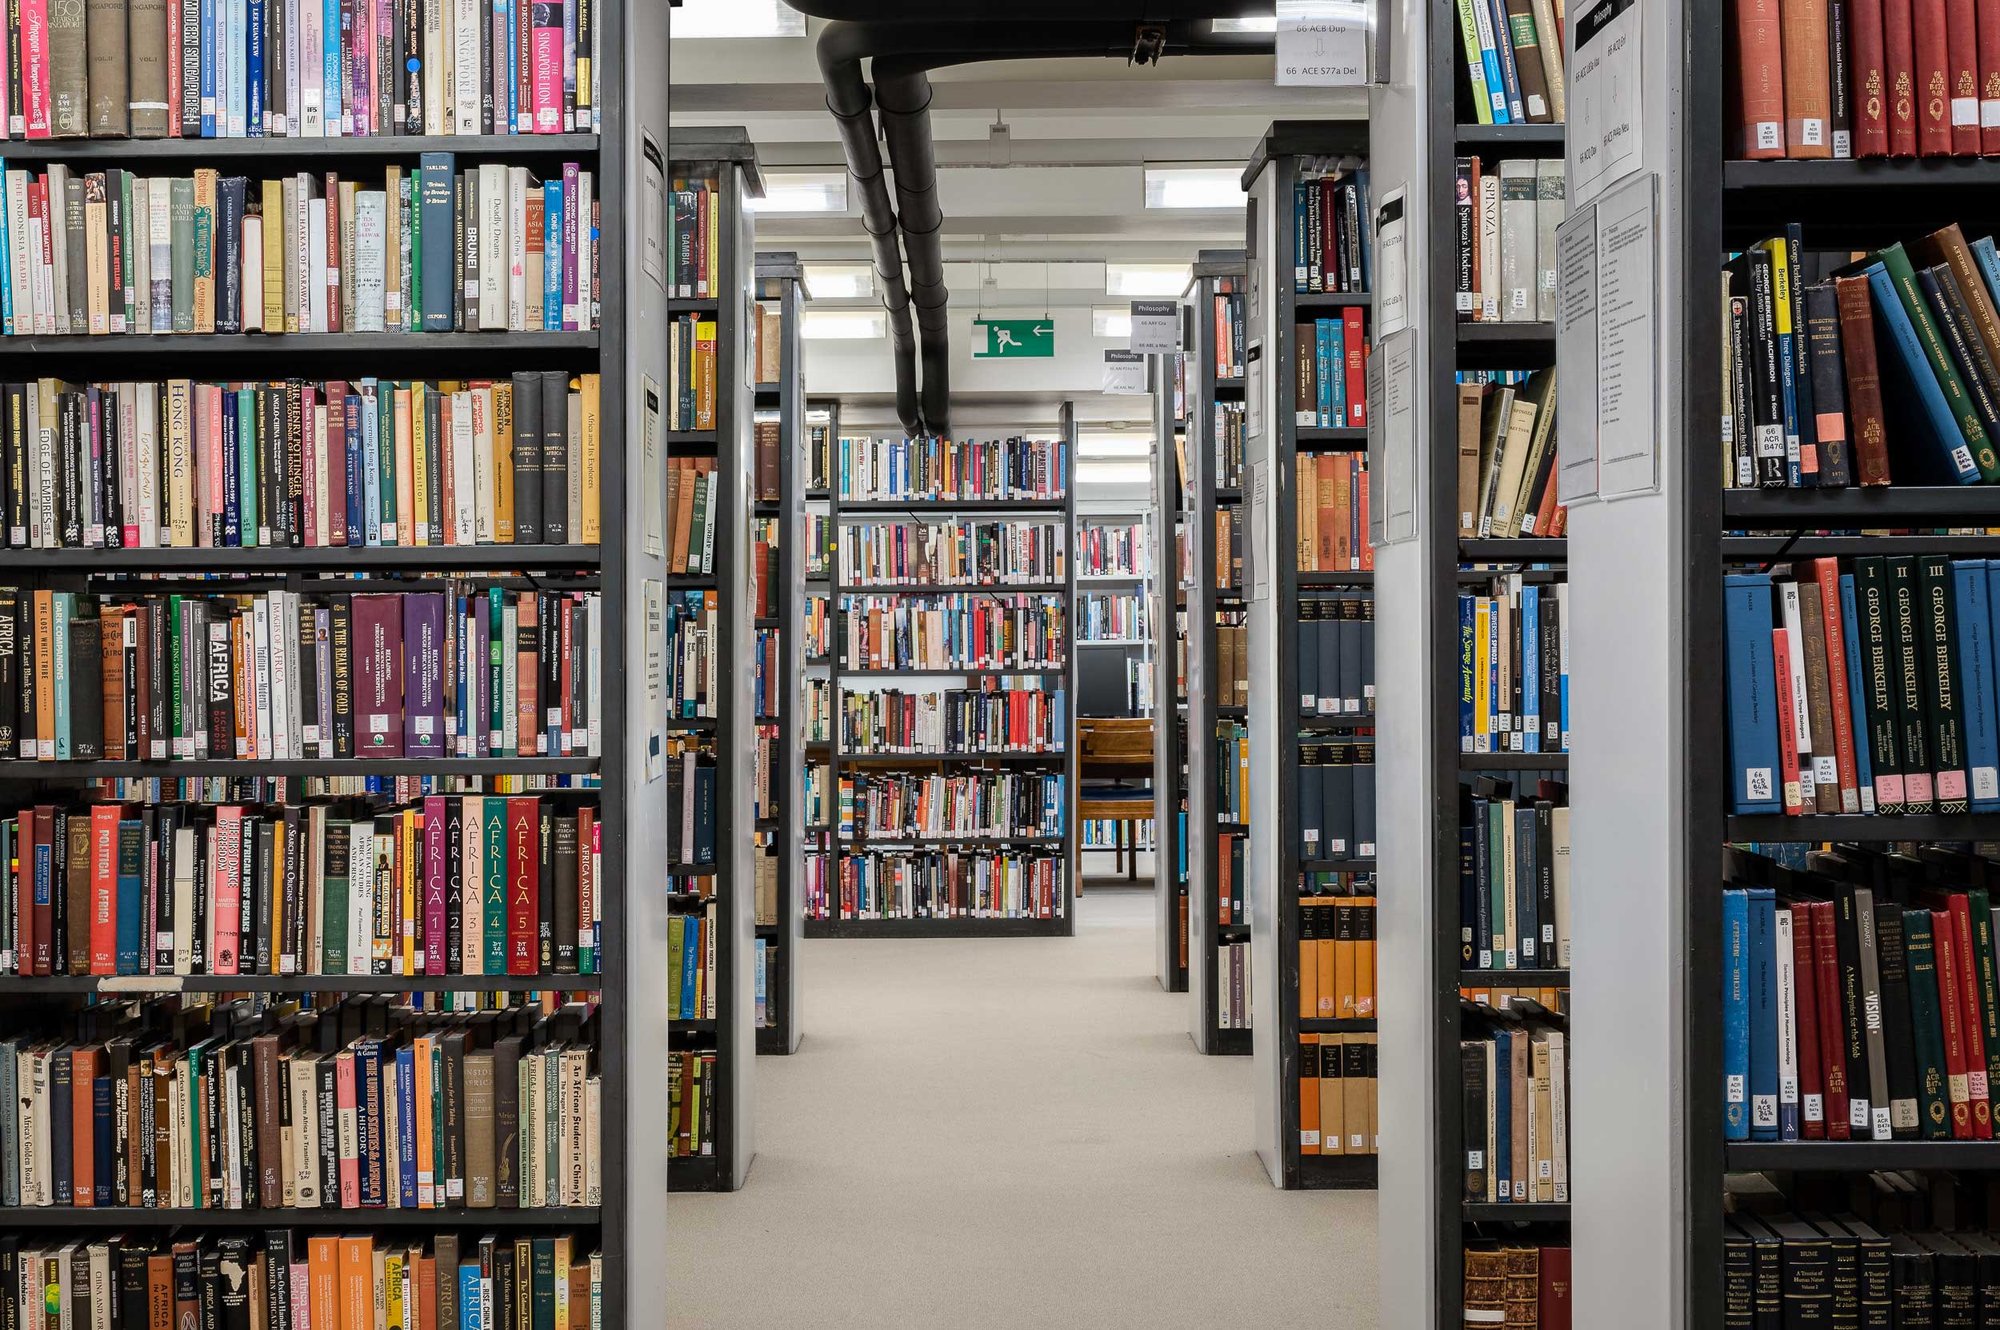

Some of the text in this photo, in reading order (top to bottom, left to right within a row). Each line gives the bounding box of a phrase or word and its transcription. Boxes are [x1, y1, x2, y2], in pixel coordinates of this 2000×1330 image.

[1329, 25, 1346, 33] Dup
[1593, 2, 1612, 27] Philosophy
[184, 0, 199, 111] MODERN SINGAPORE
[458, 27, 470, 95] SINGAPORE
[521, 6, 529, 76] DECOLONIZATION
[537, 32, 550, 104] SINGAPORE LION
[1286, 67, 1297, 75] 66
[1321, 67, 1341, 75] S77a
[1344, 67, 1357, 75] Del
[17, 199, 25, 251] INDONESIA
[493, 198, 502, 259] Deadly Dreams
[1484, 181, 1496, 237] SPINOZA
[41, 200, 50, 264] INDONESIA MATTERS
[467, 227, 477, 269] BRUNEI
[19, 254, 27, 291] READER
[300, 255, 306, 266] OF
[457, 251, 463, 262] OF
[1762, 264, 1770, 294] GEORGE
[1778, 268, 1787, 301] Berkeley
[1764, 295, 1772, 331] BERKELEY
[1767, 340, 1776, 382] ALCIPHRON
[1783, 336, 1791, 355] Three
[1783, 356, 1792, 387] Dialogues
[272, 394, 280, 438] ANGLO-CHINA
[1771, 394, 1776, 402] in
[172, 385, 183, 478] HONG KONG
[292, 383, 301, 496] SIR HENRY POTTINGER
[367, 412, 375, 447] Governing
[1763, 435, 1780, 443] ACR
[40, 429, 52, 523] EDGE OF EMPIRES
[367, 448, 375, 467] Hong
[587, 458, 595, 489] Explorers
[1867, 566, 1875, 578] I
[1896, 566, 1908, 578] II
[1929, 566, 1944, 578] III
[23, 635, 31, 649] The
[55, 601, 64, 680] DARK COMPANIONS
[1867, 587, 1888, 711] GEORGE BERKELEY
[1898, 587, 1918, 711] GEORGE BERKELEY
[1932, 587, 1952, 711] GEORGE BERKELEY
[23, 668, 31, 687] Blank
[212, 641, 228, 702] AFRICA
[334, 618, 348, 714] IN THE REALMS OF GOLD
[23, 689, 31, 713] Spaces
[174, 689, 180, 701] TO
[98, 829, 109, 924] POLITICAL AFRICA
[242, 820, 251, 933] THE AFRICAN PAST SPEAKS
[427, 816, 442, 904] AFRICA
[448, 816, 461, 904] AFRICA
[465, 816, 480, 904] AFRICA
[488, 815, 502, 904] AFRICA
[515, 816, 530, 904] AFRICA
[582, 843, 590, 929] AFRICA AND CHINA
[1862, 910, 1880, 1029] SCHWARTZ VISION
[1846, 973, 1856, 1015] Metaphysics
[1849, 1016, 1857, 1028] for
[1850, 1029, 1858, 1040] the
[1851, 1041, 1859, 1058] Mob
[324, 1072, 336, 1184] THE WORLD AND AFRICA
[359, 1115, 367, 1156] HISTORY
[572, 1065, 582, 1190] An African Student in China
[441, 1271, 454, 1327] AFRICA
